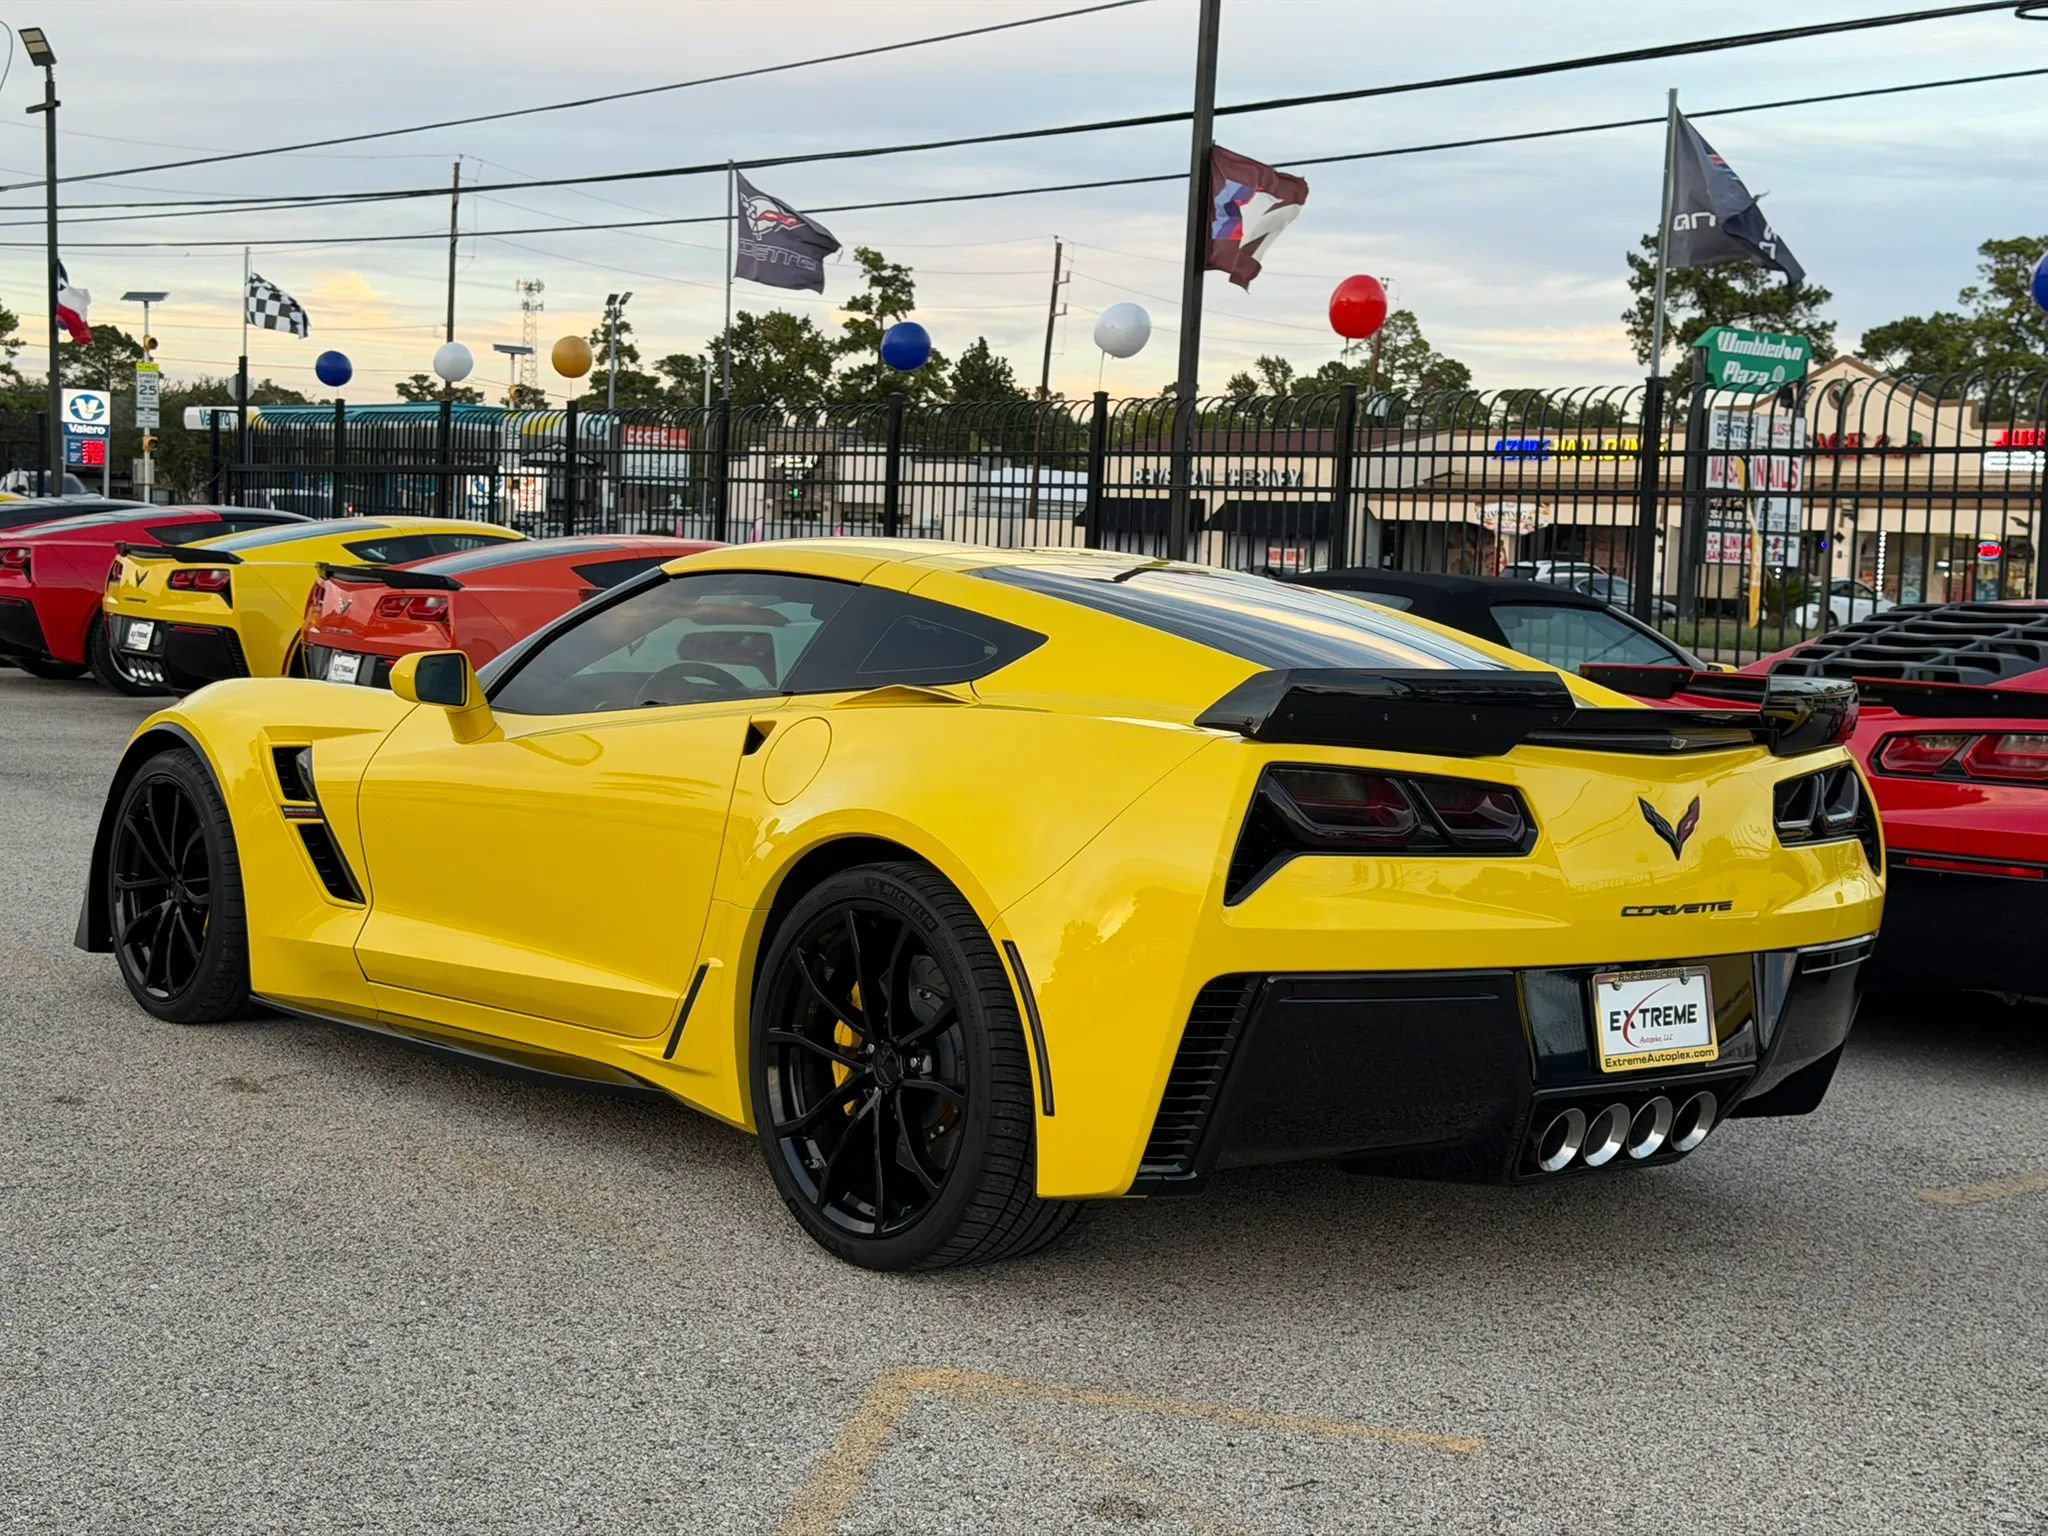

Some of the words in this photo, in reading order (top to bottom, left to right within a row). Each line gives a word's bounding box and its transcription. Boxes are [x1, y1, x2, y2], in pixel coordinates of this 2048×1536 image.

[1717, 331, 1803, 360] Wimbledon
[1723, 360, 1770, 385] Plaza
[139, 385, 157, 396] 25
[68, 423, 106, 435] Valero
[1755, 457, 1799, 489] NAILS
[881, 882, 937, 932] MICHELIN
[1621, 900, 1733, 917] CORVETTE
[1609, 1003, 1698, 1032] EXTREME
[1663, 1033, 1674, 1042] LLC
[1604, 1048, 1715, 1068] ExtremeAutoplex.com
